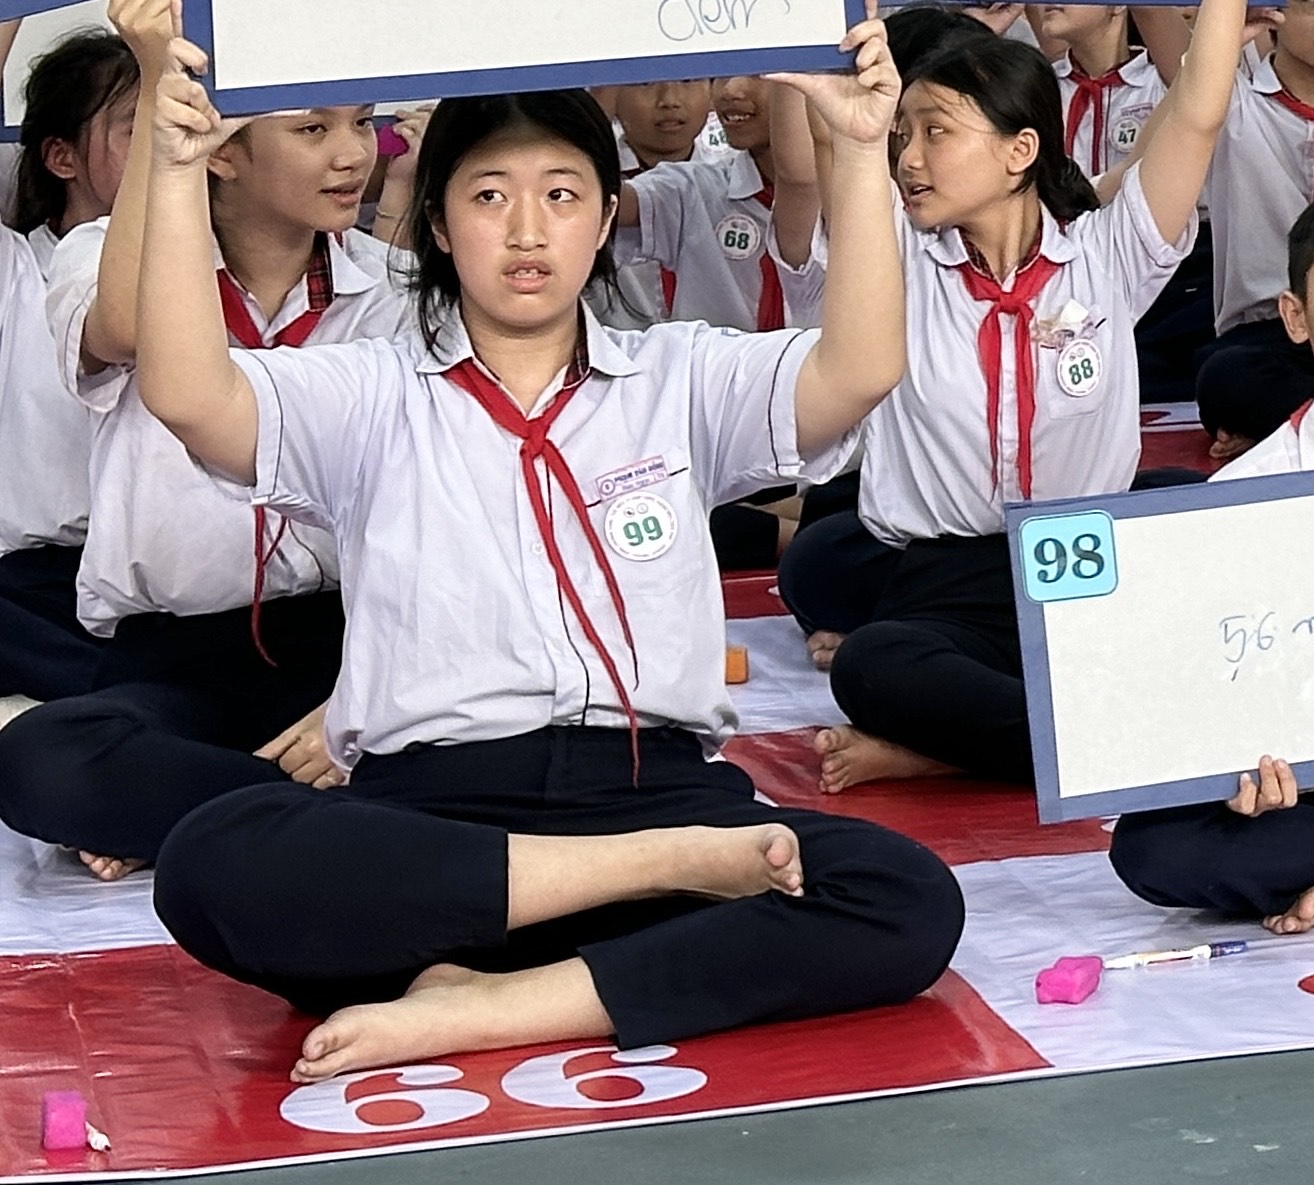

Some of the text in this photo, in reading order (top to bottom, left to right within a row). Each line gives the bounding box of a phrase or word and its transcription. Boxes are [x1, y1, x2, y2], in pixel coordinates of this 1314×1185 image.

[1118, 128, 1137, 144] 47
[724, 229, 750, 250] 68
[1068, 357, 1094, 386] 88
[622, 515, 664, 547] 99
[1033, 533, 1105, 583] 98
